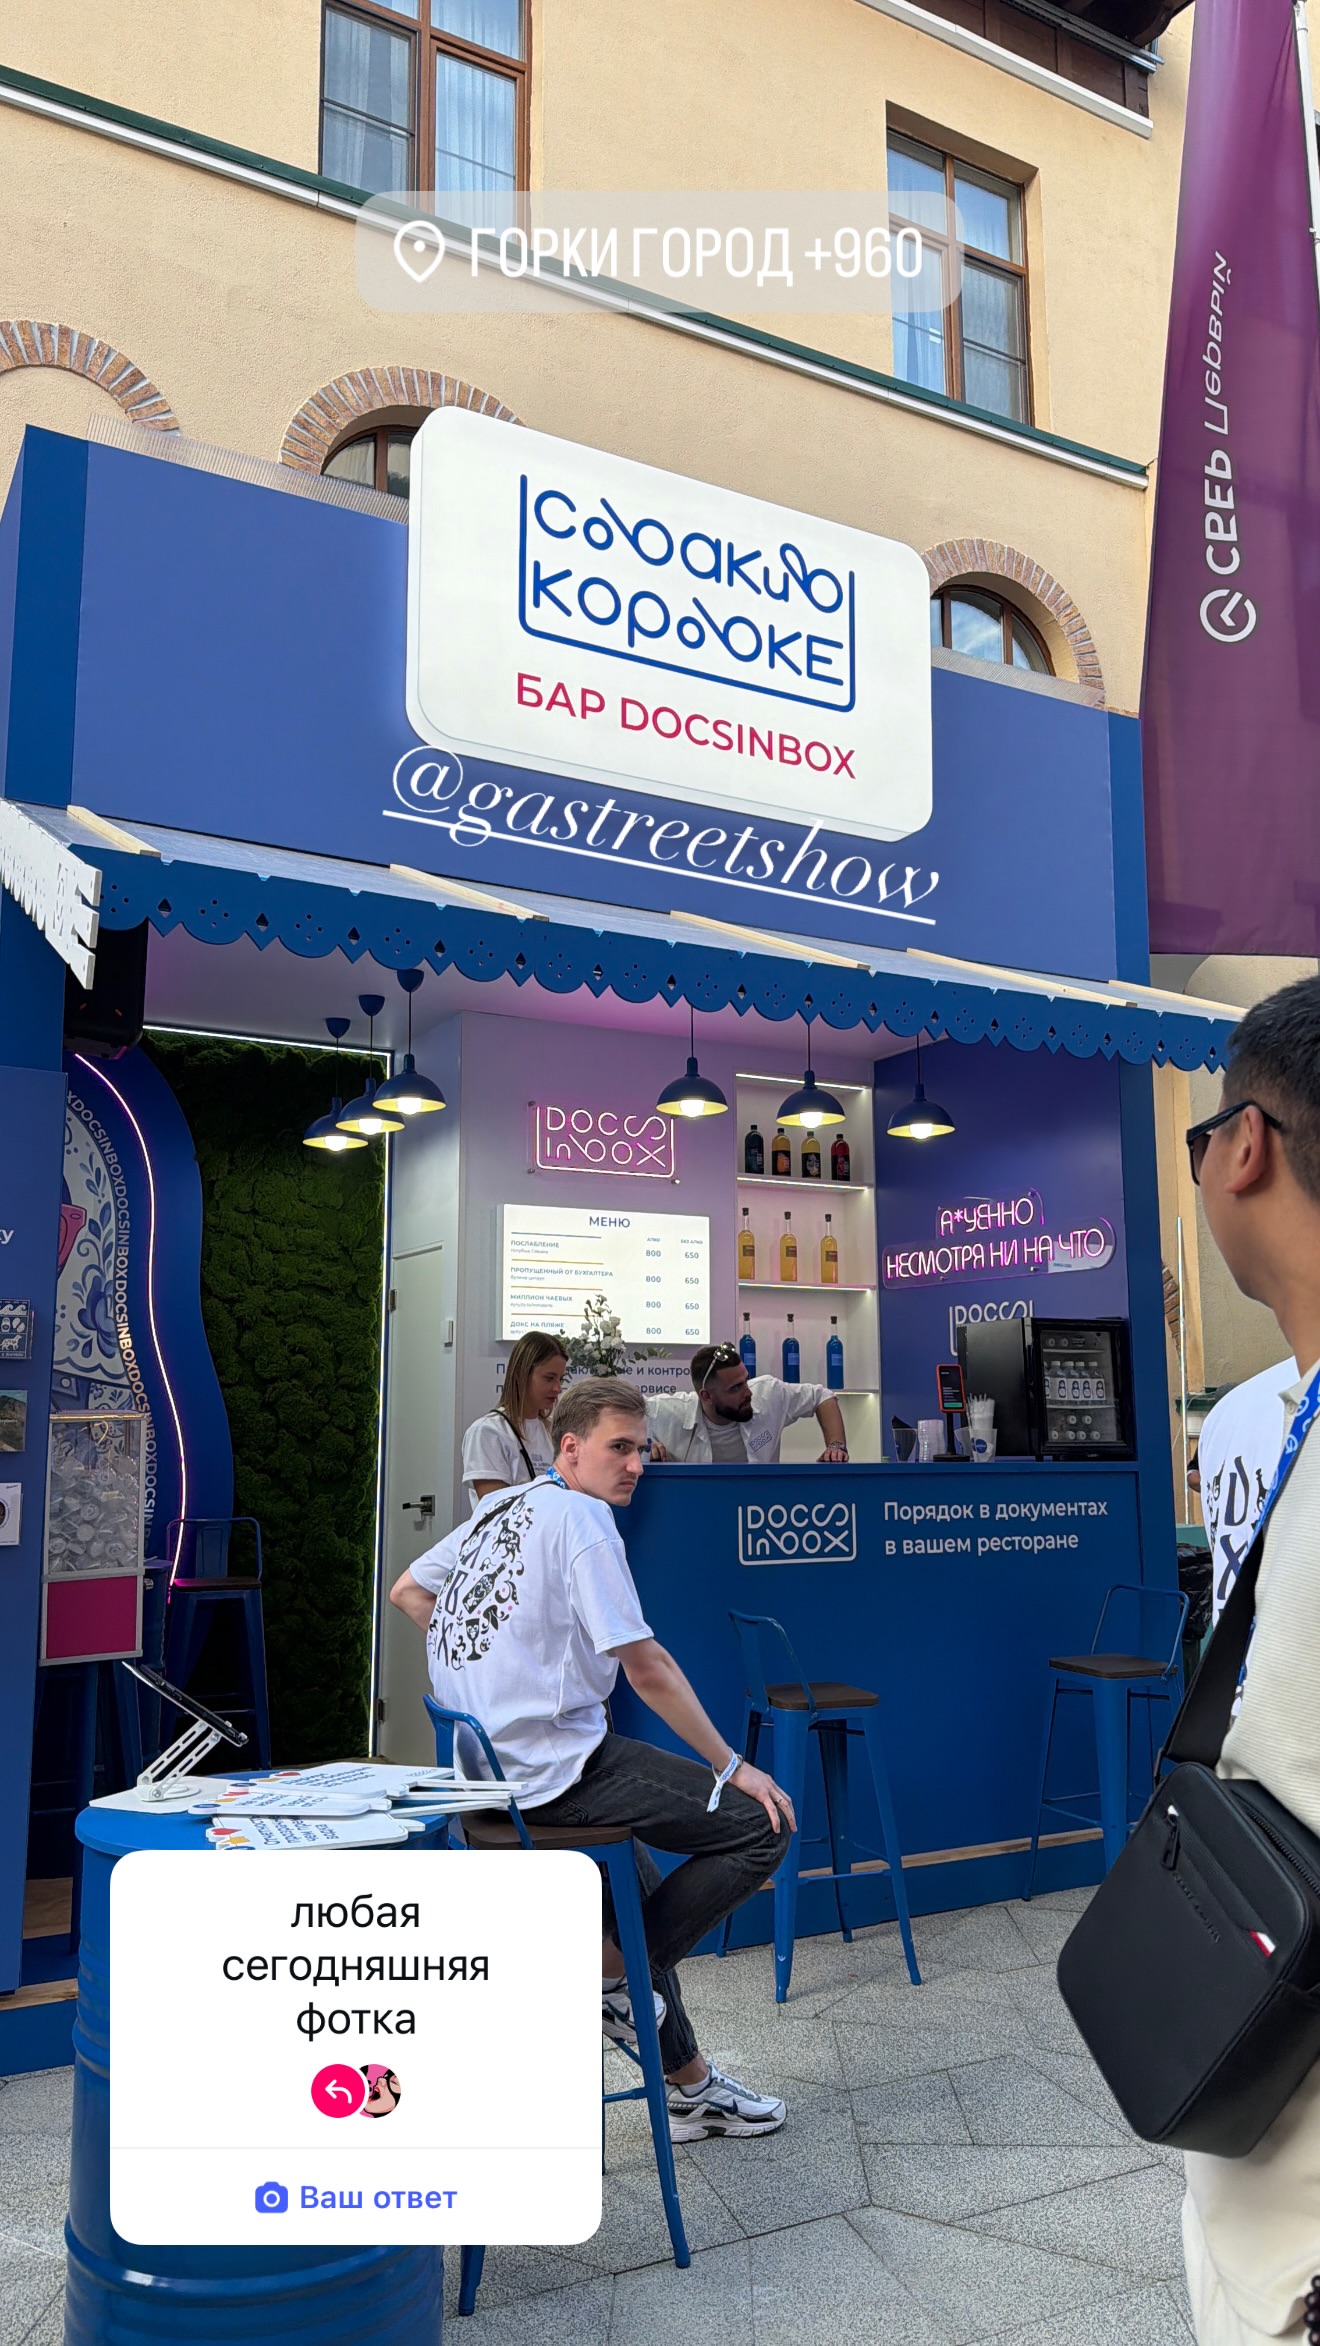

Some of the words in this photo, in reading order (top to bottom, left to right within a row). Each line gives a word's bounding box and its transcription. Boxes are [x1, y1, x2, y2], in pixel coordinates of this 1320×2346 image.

[516, 672, 605, 721] БАР
[620, 696, 857, 780] DOCSINBOX
[589, 1216, 631, 1229] МЕНЮ
[510, 1240, 560, 1249] ПОСЛАБЛЕНИЕ
[645, 1249, 662, 1258] 800
[684, 1251, 700, 1260] 650
[886, 1243, 985, 1279] НЕСМОТРЯ
[990, 1238, 1018, 1268] НИ
[1023, 1235, 1054, 1264] НА
[1057, 1228, 1105, 1259] ЧТО
[510, 1266, 564, 1275] ПРОПУЩЕННЫЙ
[574, 1270, 614, 1278] БУХГАЛТЕРА
[645, 1275, 662, 1284] 800
[684, 1276, 700, 1286] 650
[645, 1301, 662, 1309] 800
[684, 1302, 700, 1311] 650
[645, 1327, 662, 1335] 800
[684, 1328, 700, 1337] 650
[647, 1366, 691, 1378] контро
[884, 1501, 974, 1524] Порядок
[979, 1504, 990, 1519] в
[995, 1500, 1108, 1523] документах
[885, 1539, 897, 1555] в
[903, 1535, 971, 1555] вашем
[977, 1531, 1079, 1557] ресторане
